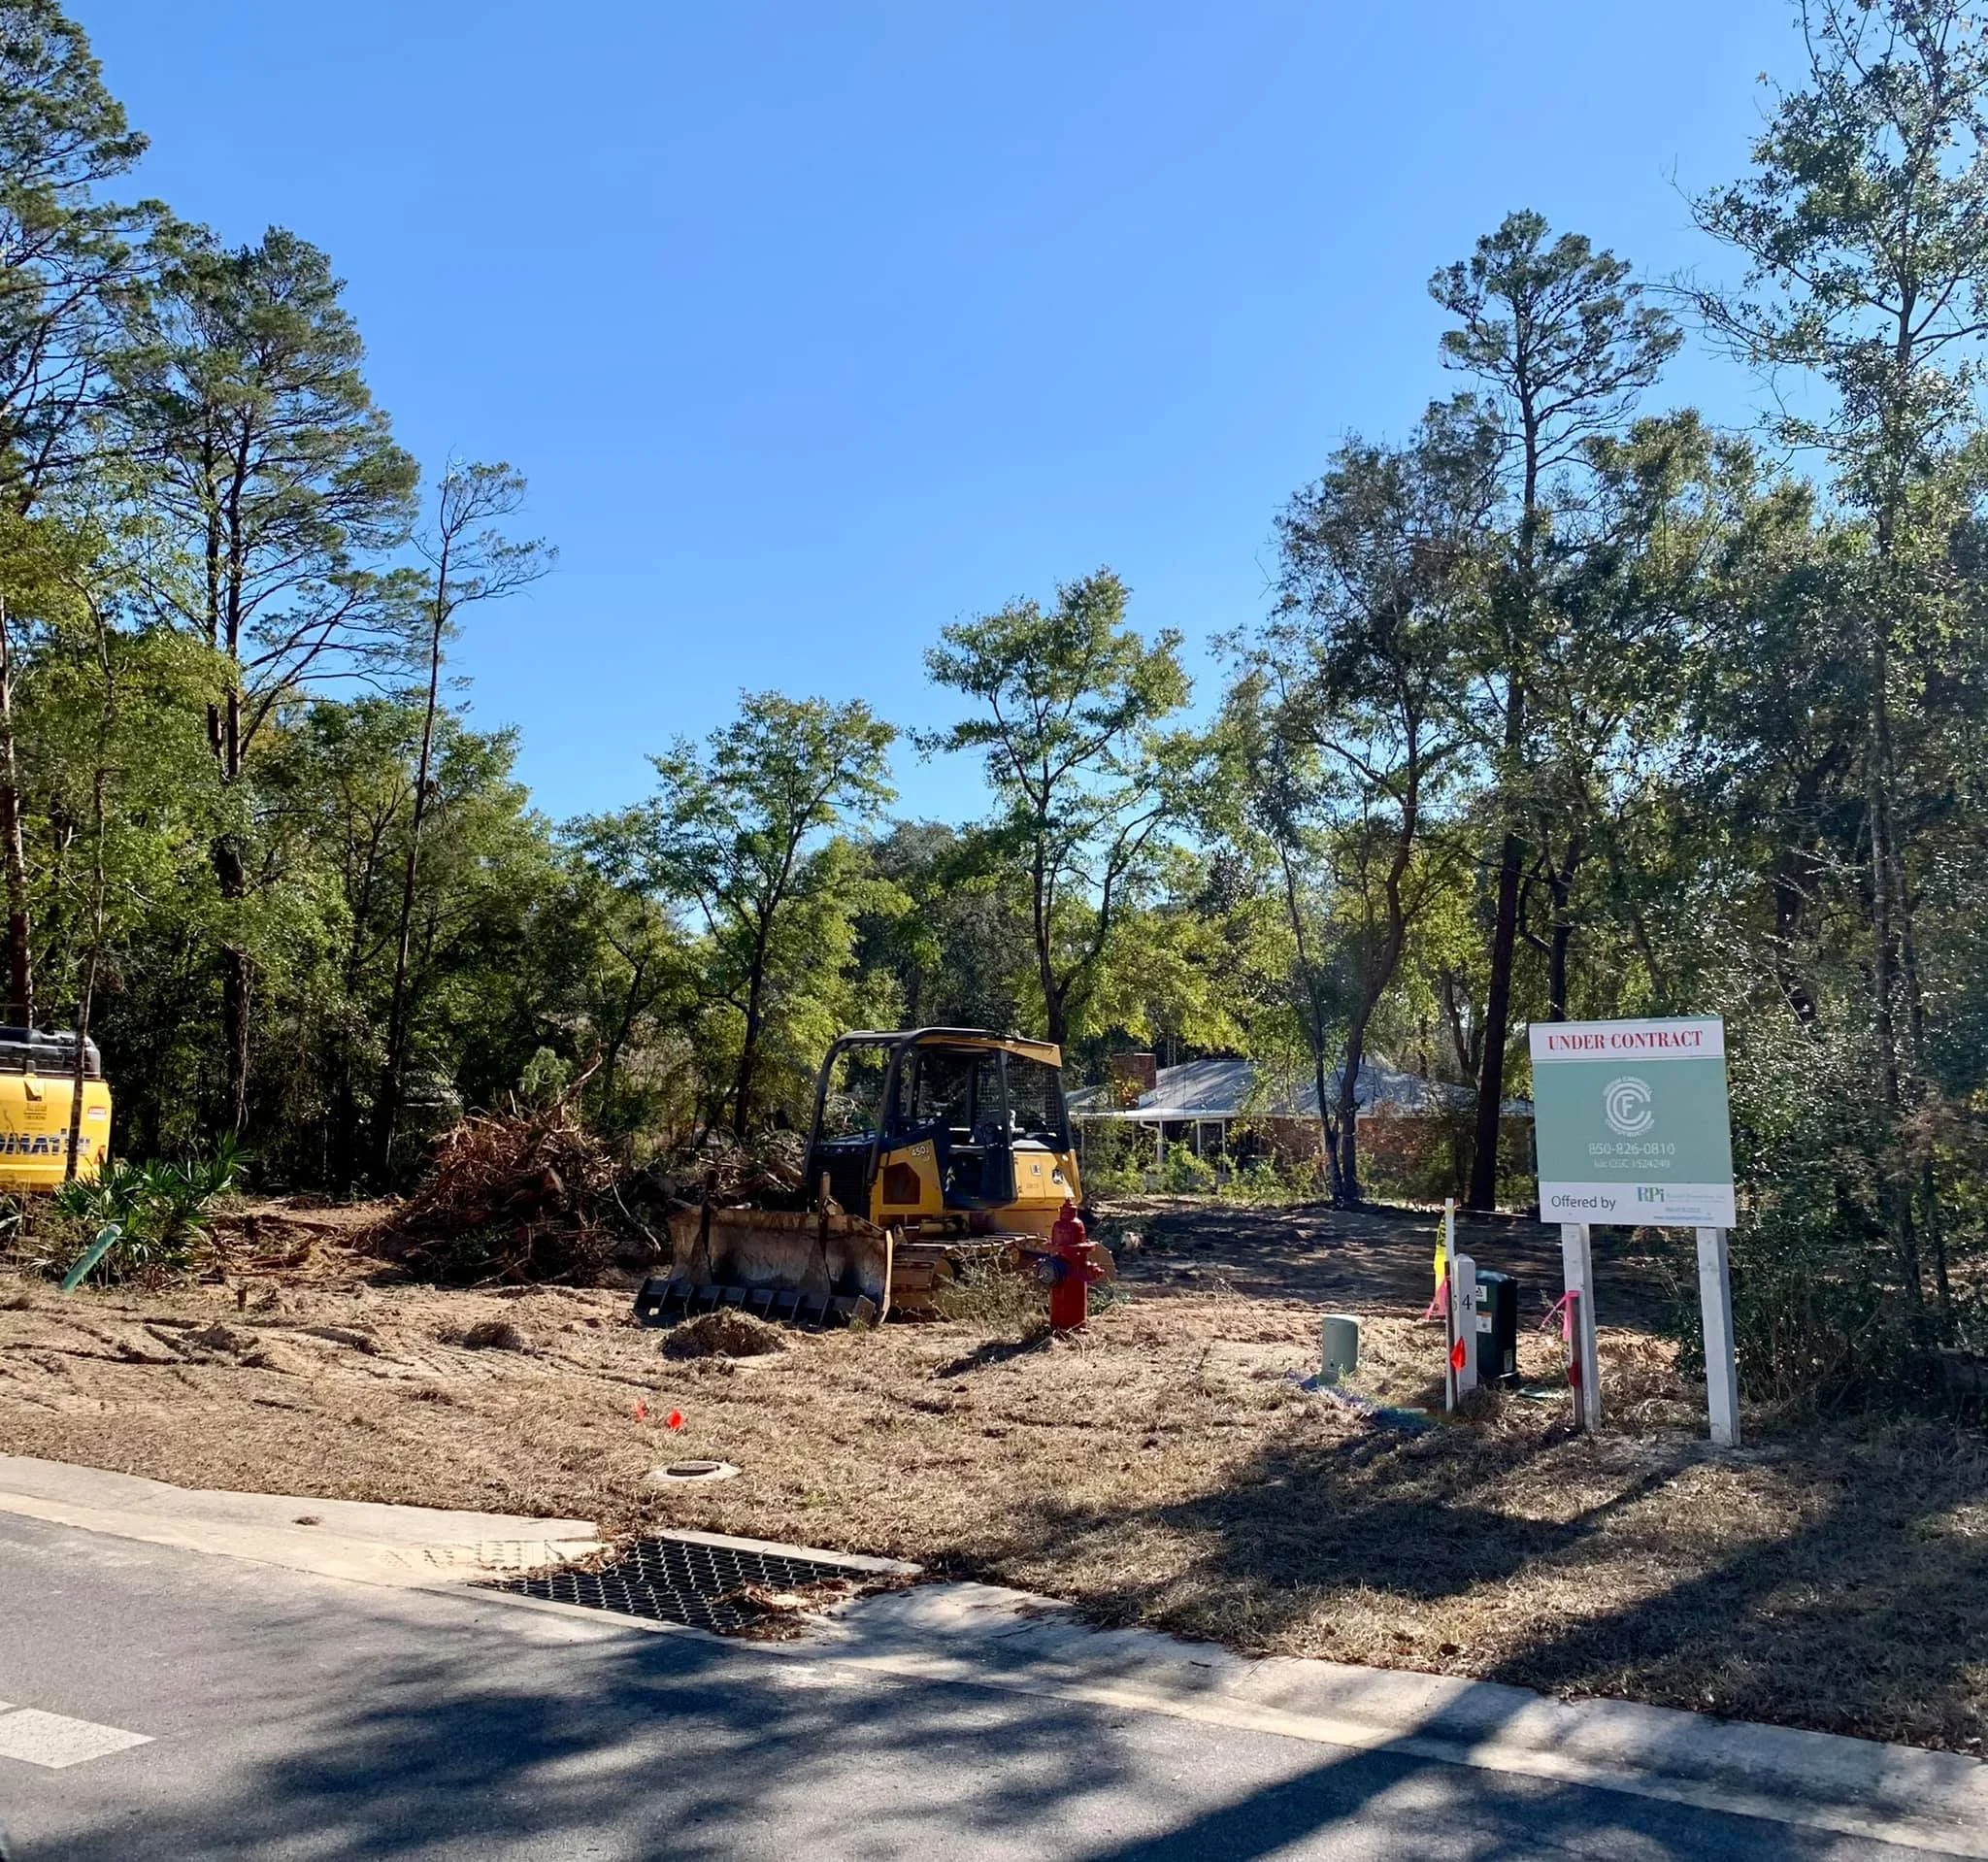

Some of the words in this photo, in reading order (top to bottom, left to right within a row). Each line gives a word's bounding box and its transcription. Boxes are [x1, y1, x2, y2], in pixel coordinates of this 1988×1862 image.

[1548, 1034, 1605, 1050] UNDER
[1610, 1030, 1703, 1048] CONTRACT
[1588, 1142, 1675, 1155] 850-826-0810
[1551, 1195, 1597, 1209] Offered
[1601, 1196, 1616, 1212] by
[1462, 1293, 1473, 1311] 4
